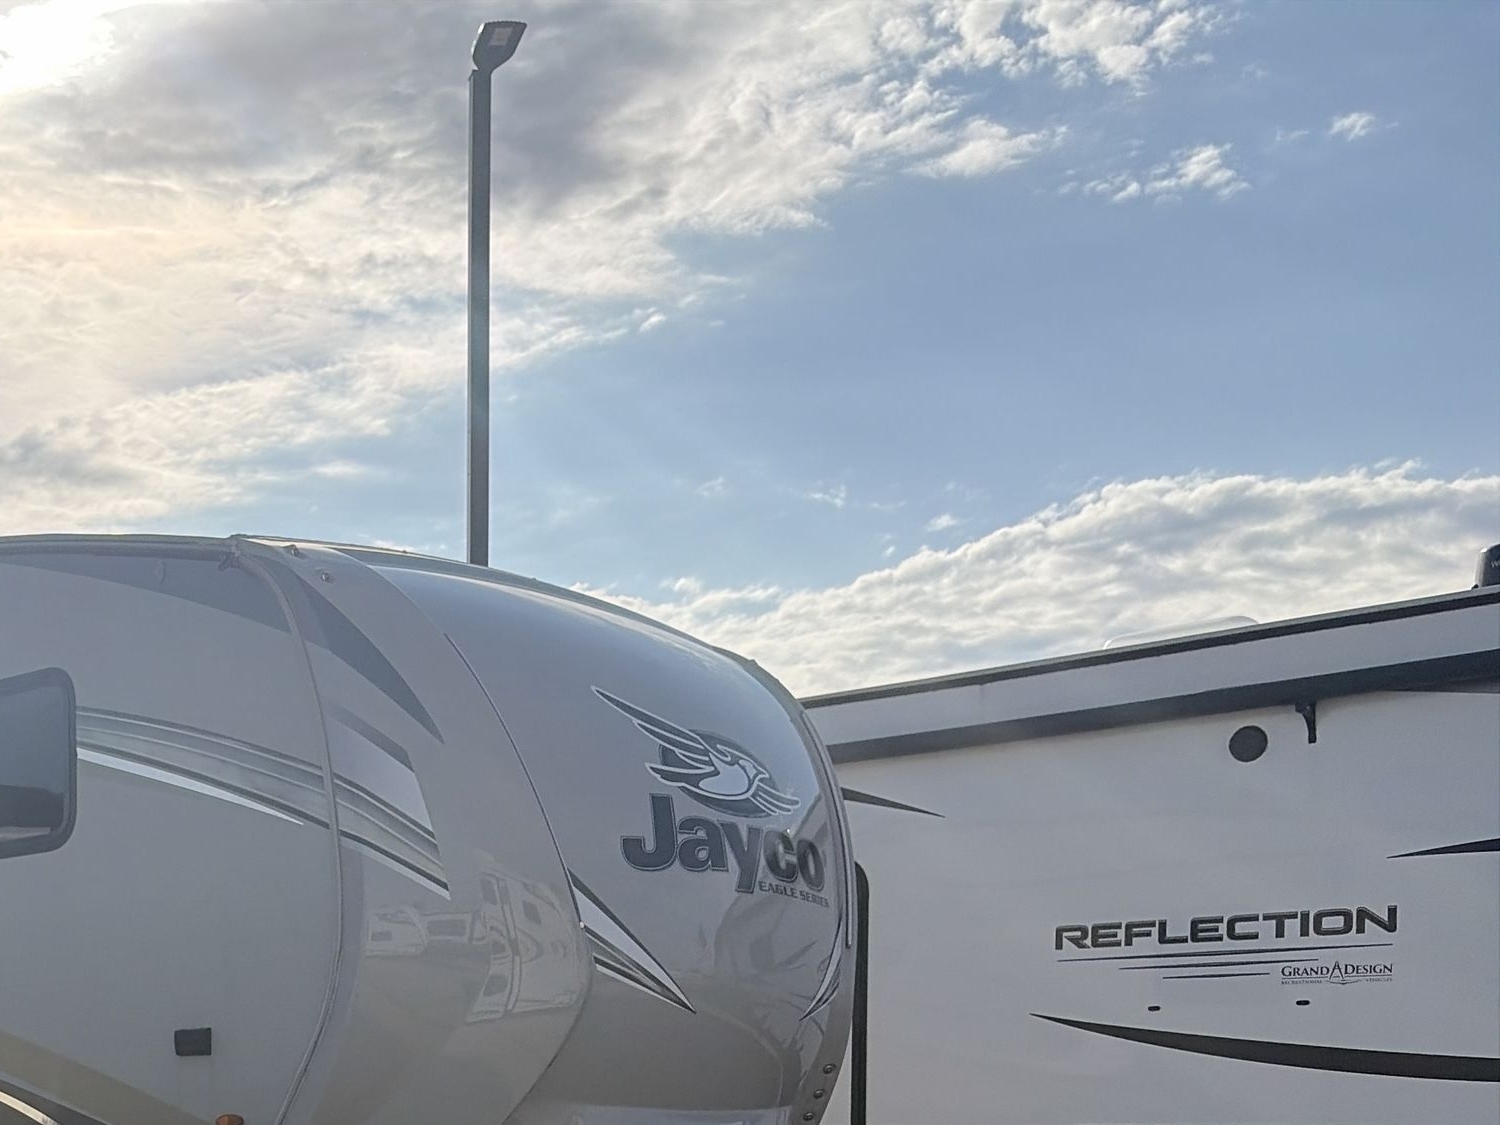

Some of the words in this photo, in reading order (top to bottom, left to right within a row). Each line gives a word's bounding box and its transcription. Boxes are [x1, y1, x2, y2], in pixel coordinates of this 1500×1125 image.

[619, 792, 826, 894] Jayco
[758, 880, 798, 899] EAGLE
[799, 890, 830, 908] SERIES
[1054, 904, 1398, 950] REFLECTION
[1281, 966, 1330, 977] GRAND
[1344, 963, 1393, 975] DESIGN
